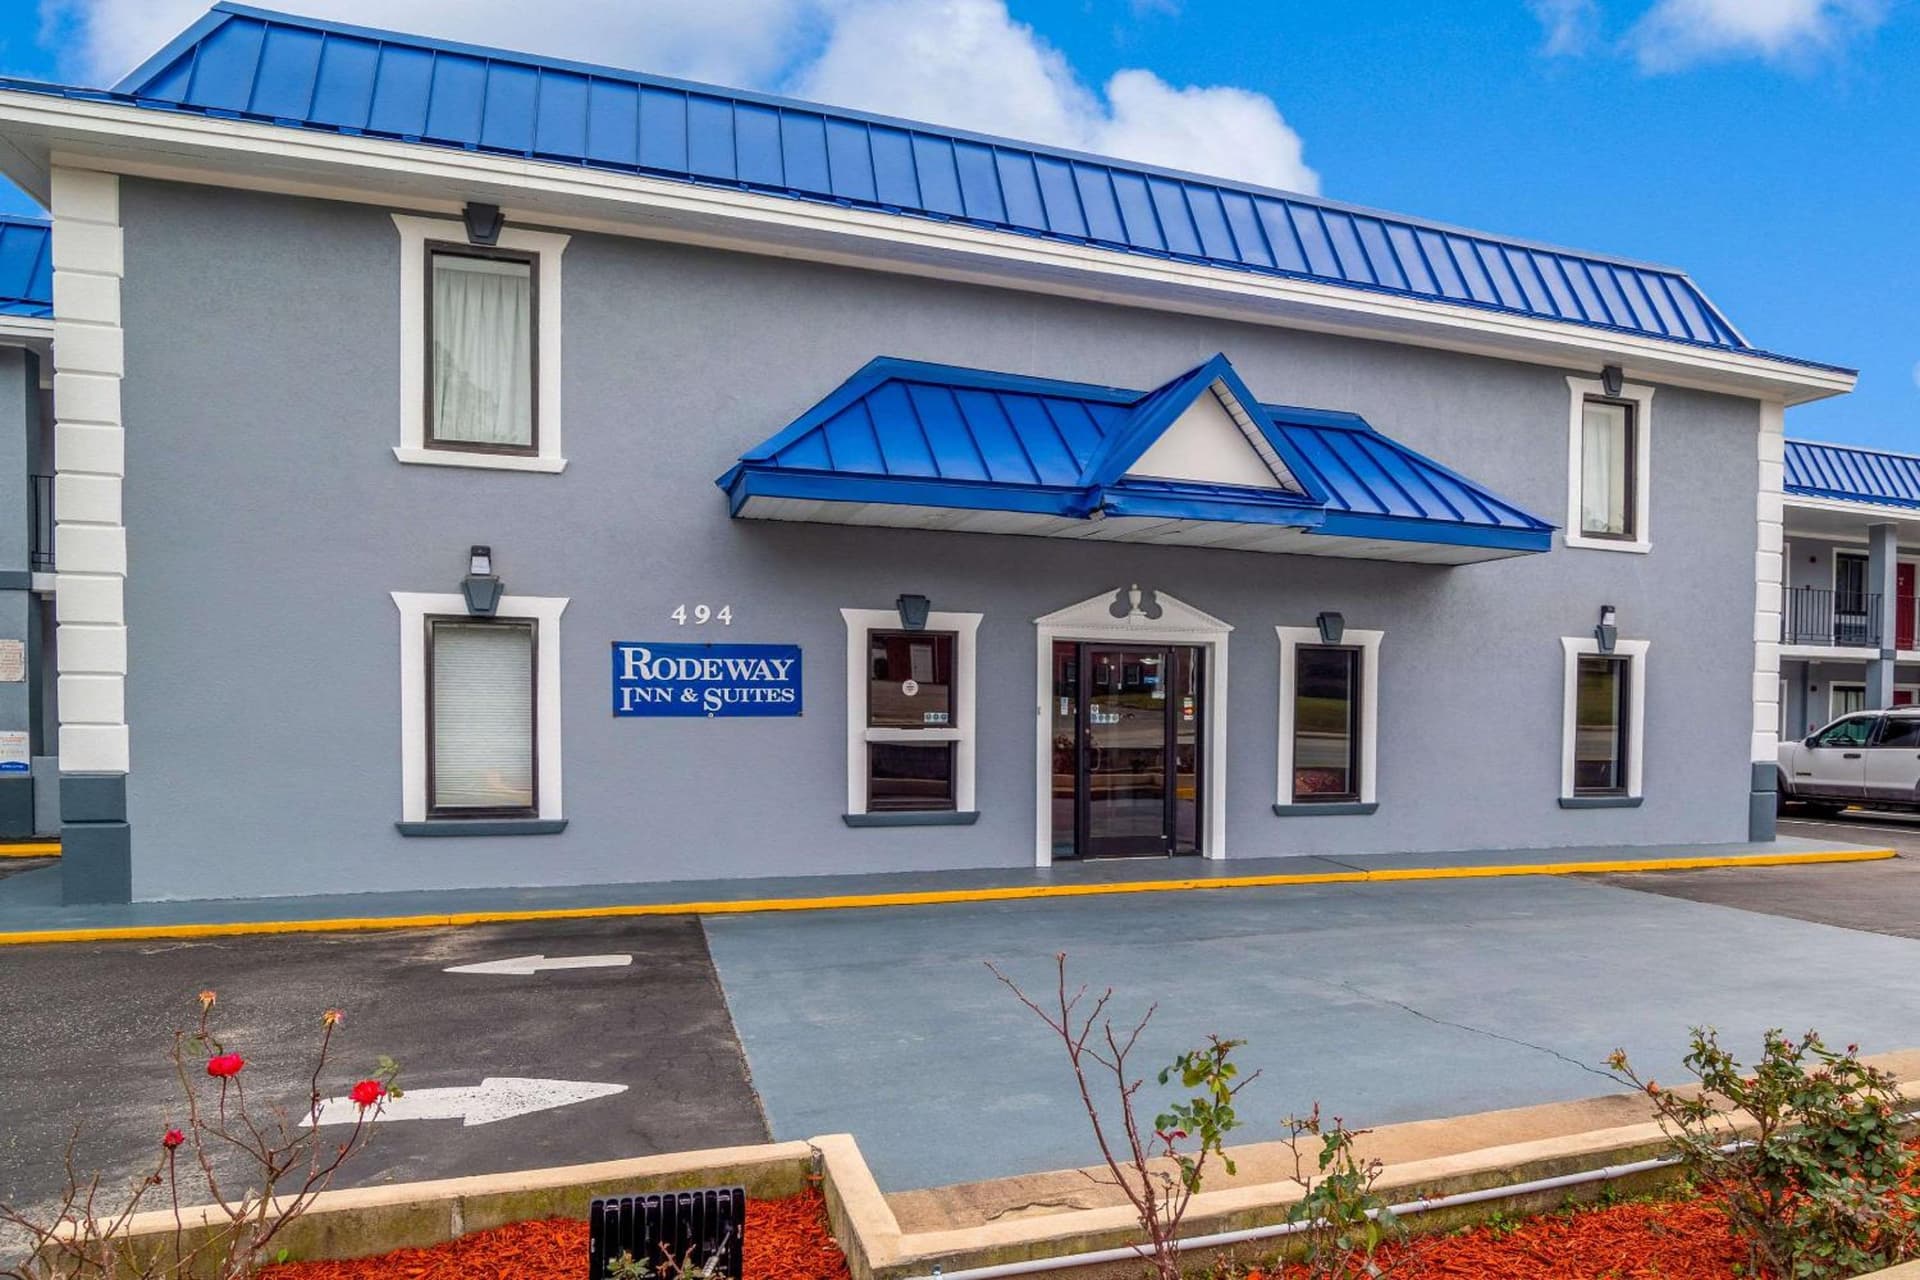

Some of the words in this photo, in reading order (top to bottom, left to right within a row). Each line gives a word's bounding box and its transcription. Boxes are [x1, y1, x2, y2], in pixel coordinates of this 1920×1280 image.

[671, 604, 733, 625] 494
[619, 647, 795, 681] RODEWAY
[620, 687, 674, 711] INN
[680, 687, 699, 703] &
[703, 687, 795, 712] SUITES
